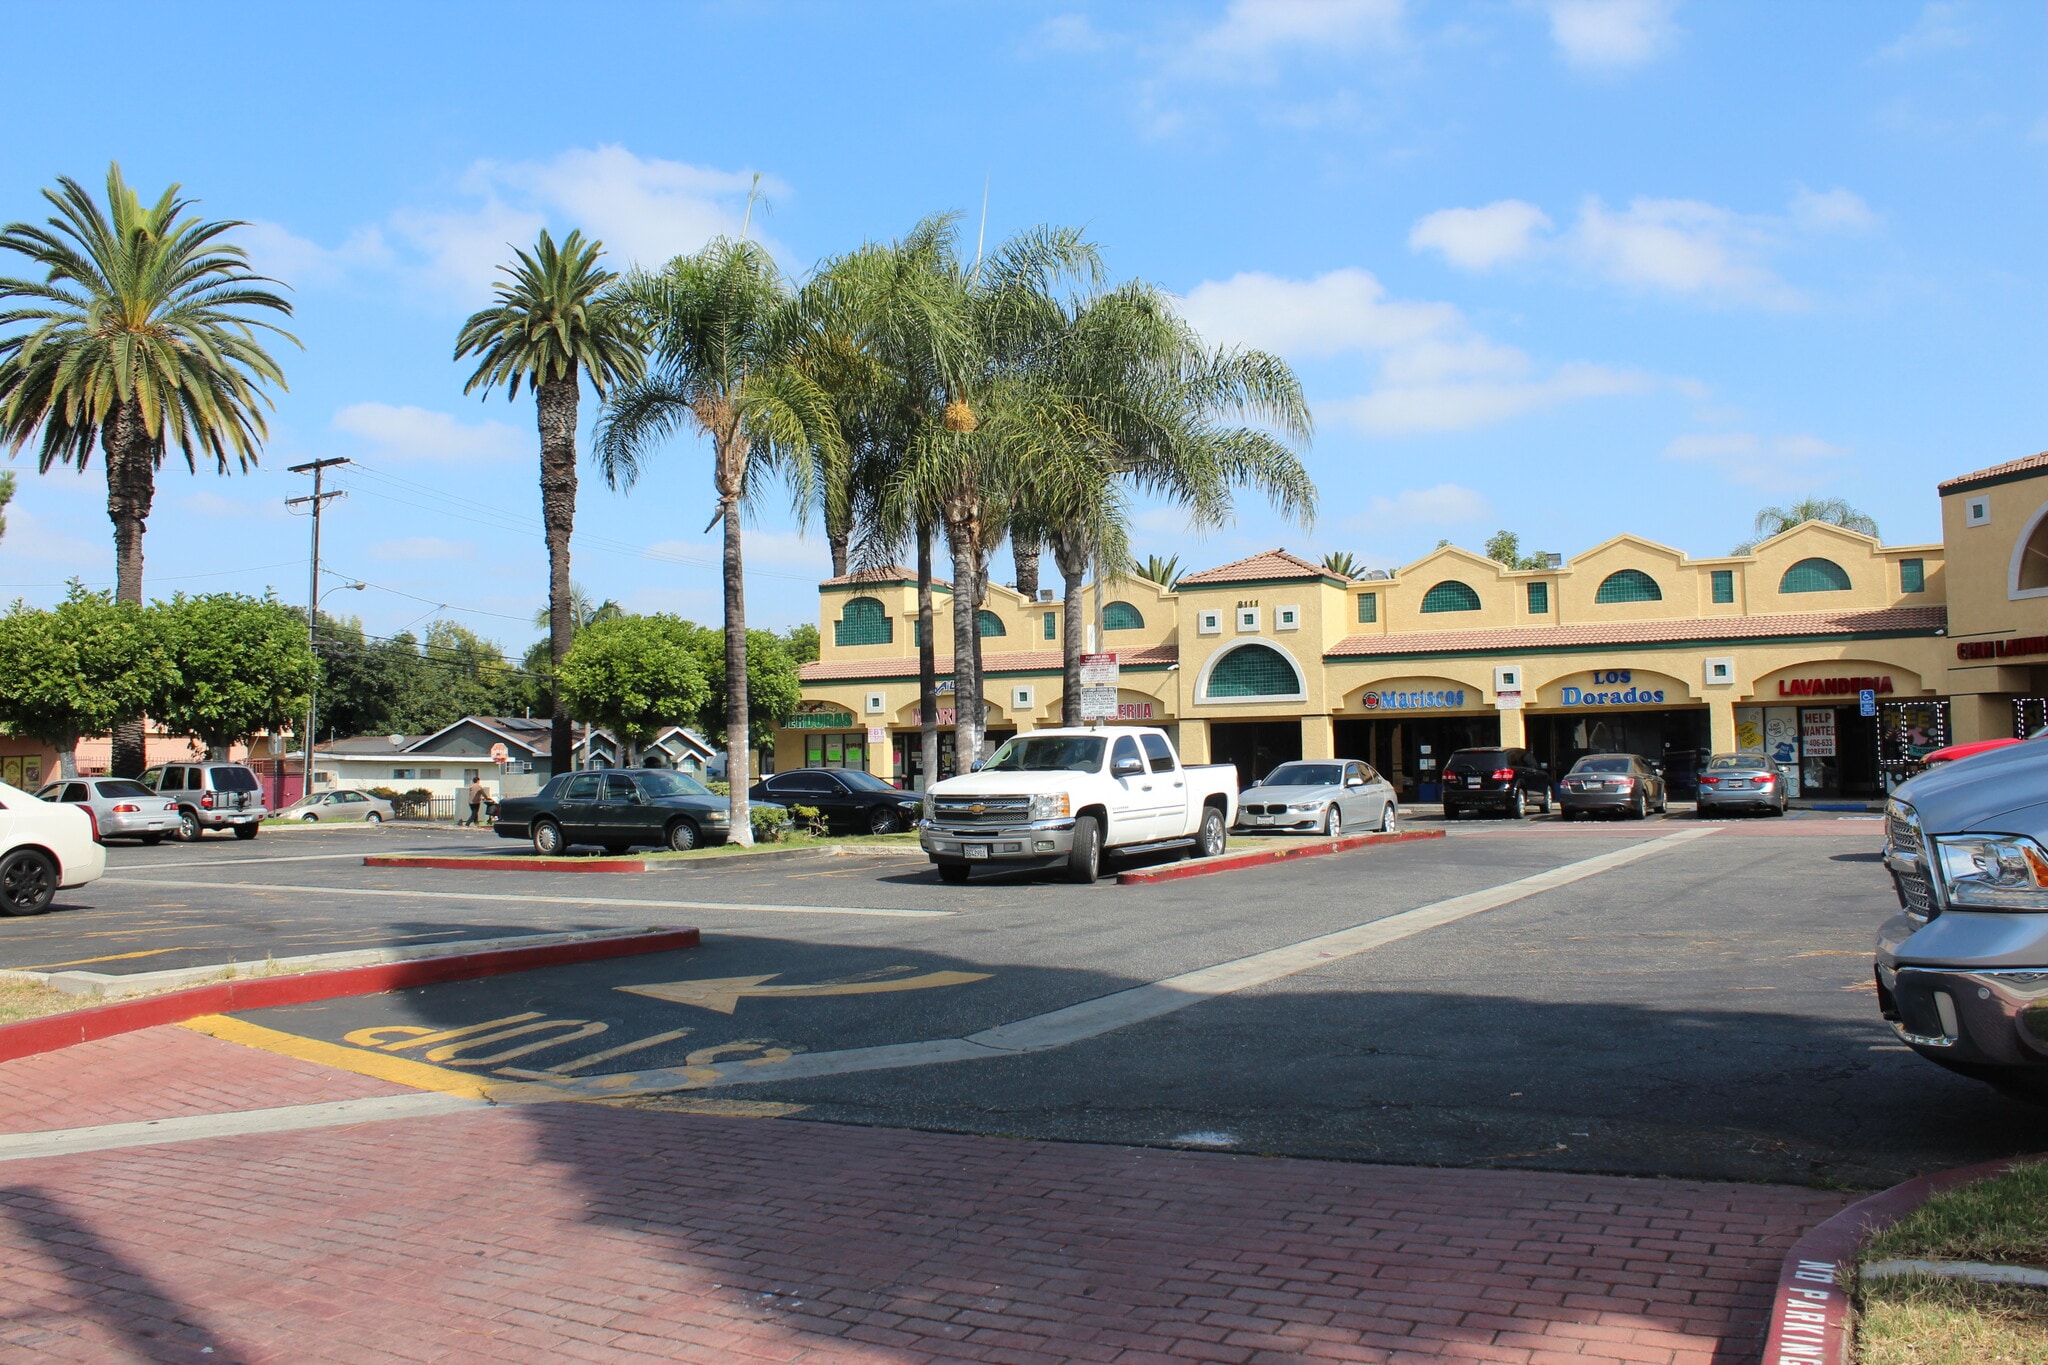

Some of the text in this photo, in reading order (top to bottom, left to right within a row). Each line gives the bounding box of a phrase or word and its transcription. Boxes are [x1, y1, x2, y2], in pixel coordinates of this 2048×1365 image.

[1593, 671, 1632, 685] LOS
[1779, 676, 1893, 695] LAVANDERIA
[1379, 689, 1465, 709] Mariscos
[1561, 686, 1665, 706] Dorados
[1804, 712, 1832, 723] HELP
[869, 728, 884, 736] EBT
[1795, 1259, 1836, 1284] NO
[1779, 1287, 1830, 1365] PARKING
